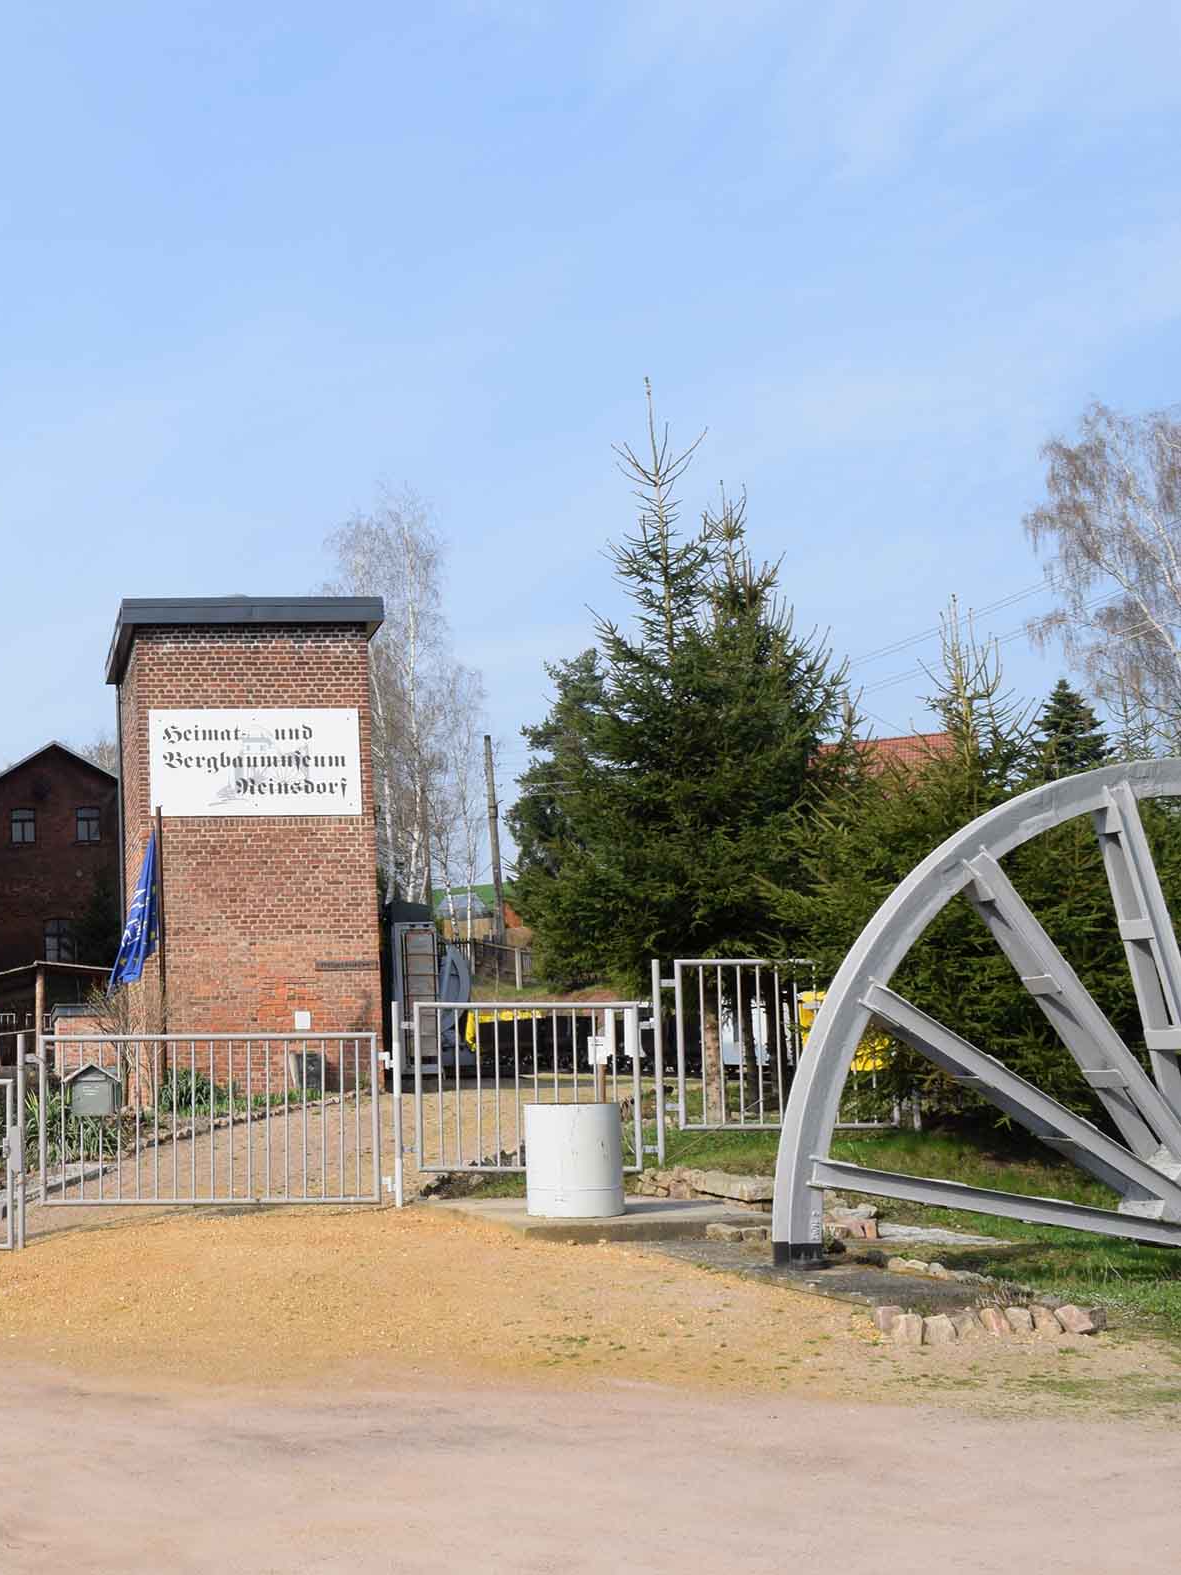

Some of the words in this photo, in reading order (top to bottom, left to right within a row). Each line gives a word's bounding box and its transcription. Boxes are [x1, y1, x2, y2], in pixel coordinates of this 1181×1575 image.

[163, 725, 246, 744] Heimat-
[275, 724, 313, 741] und
[236, 778, 347, 798] Reinsdorf
